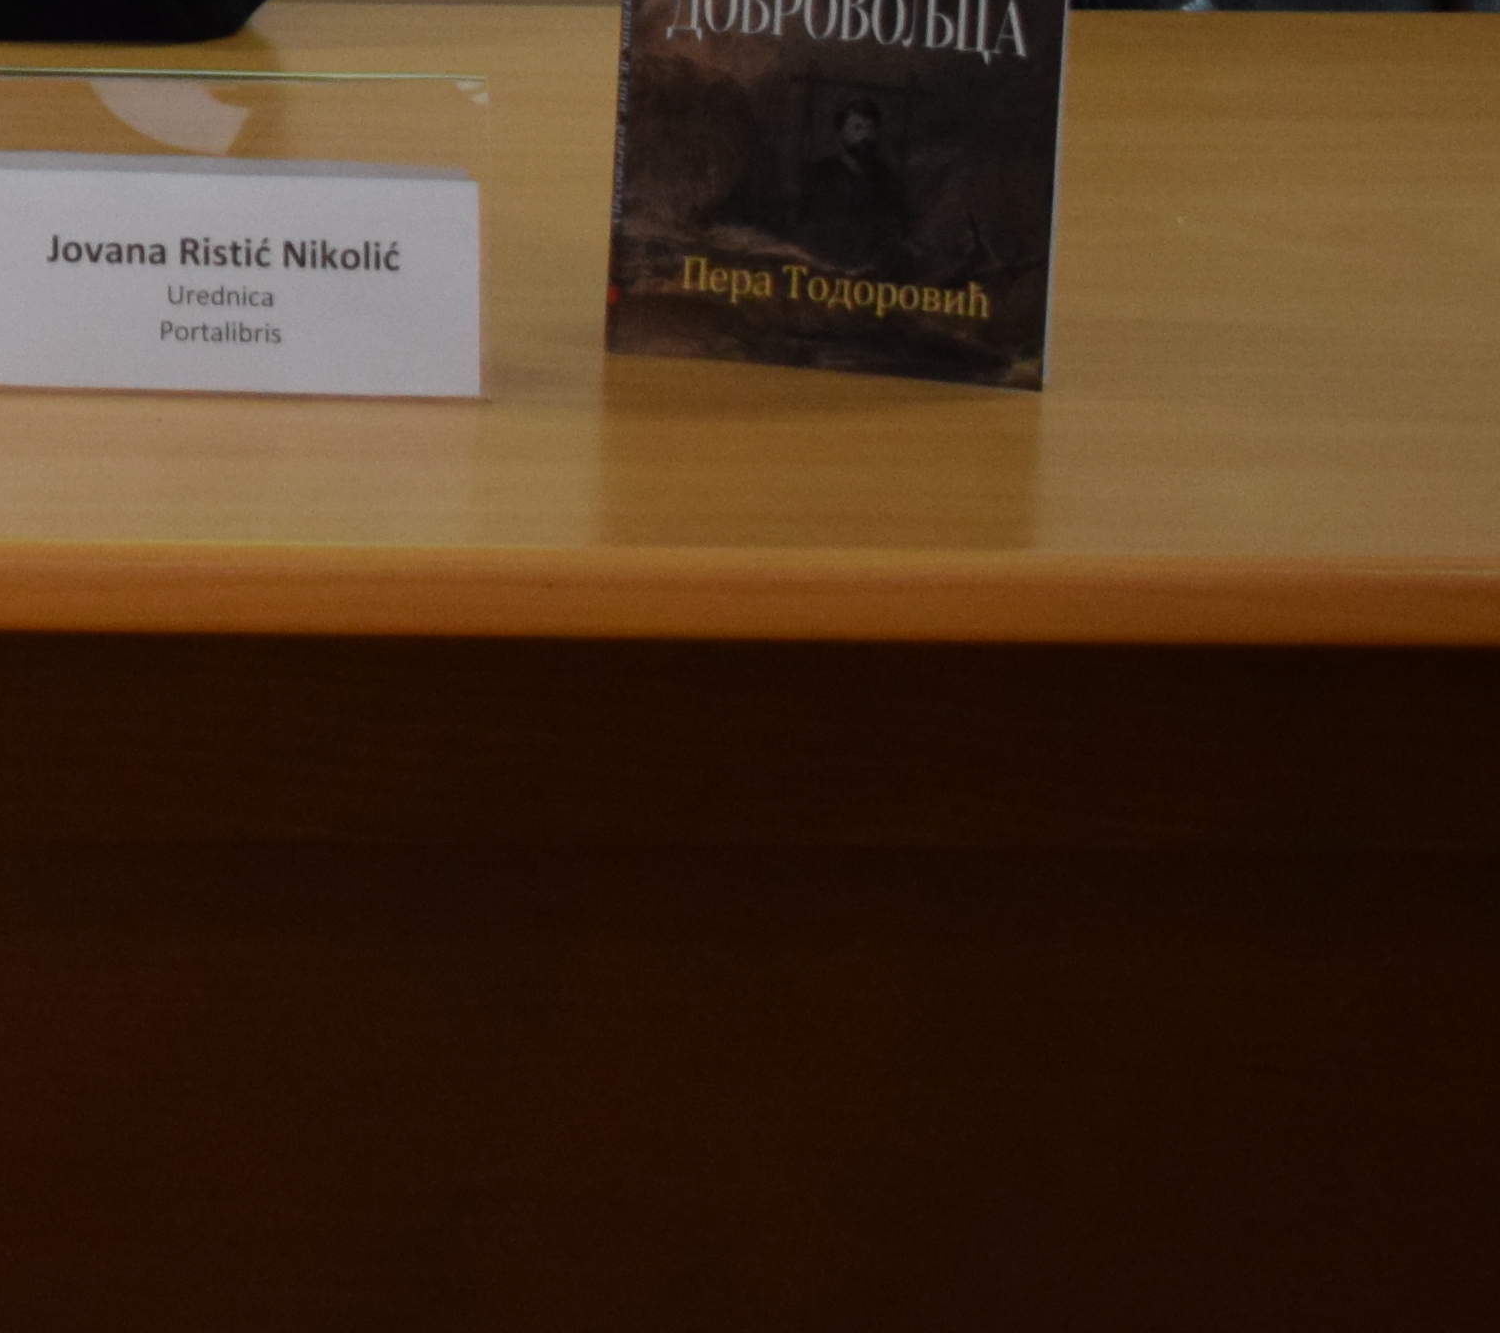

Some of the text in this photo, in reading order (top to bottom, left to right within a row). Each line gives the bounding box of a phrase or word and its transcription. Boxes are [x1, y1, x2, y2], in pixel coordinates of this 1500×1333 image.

[46, 234, 400, 272] Jovana Ristić Nikolić
[166, 284, 274, 308] Urednica
[681, 255, 990, 320] Пера Тодоровић
[160, 319, 283, 346] Portalibris
